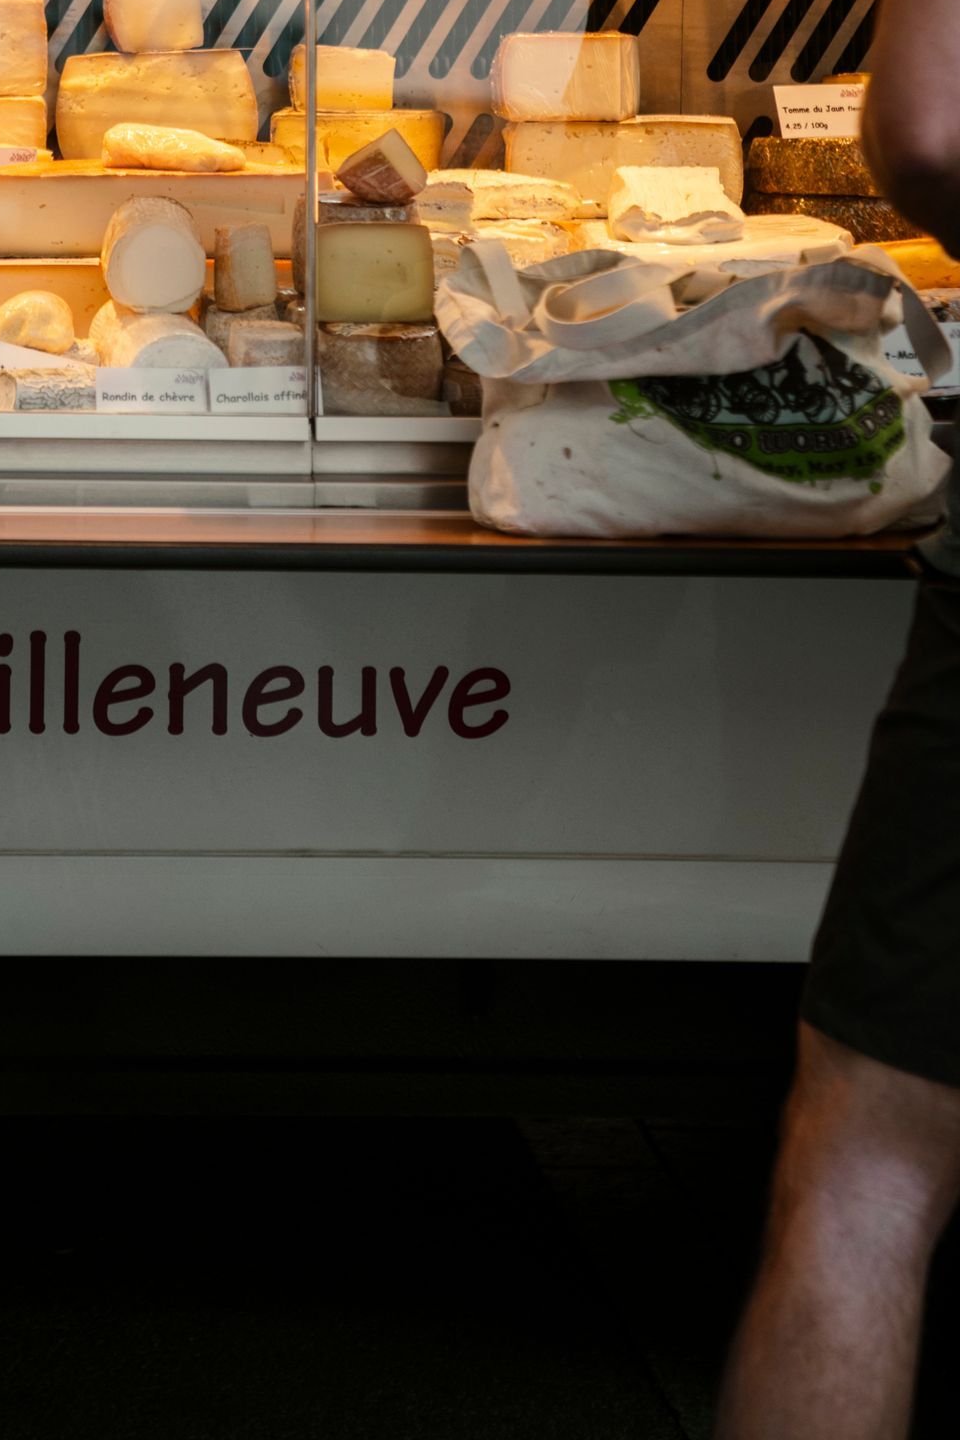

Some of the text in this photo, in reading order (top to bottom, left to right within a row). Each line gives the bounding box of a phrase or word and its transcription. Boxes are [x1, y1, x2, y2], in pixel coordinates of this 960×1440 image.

[782, 106, 810, 114] Tomme
[813, 105, 823, 113] du
[811, 122, 828, 130] 100g
[102, 392, 196, 402] Rondin de chèvre
[216, 392, 269, 404] Charollais
